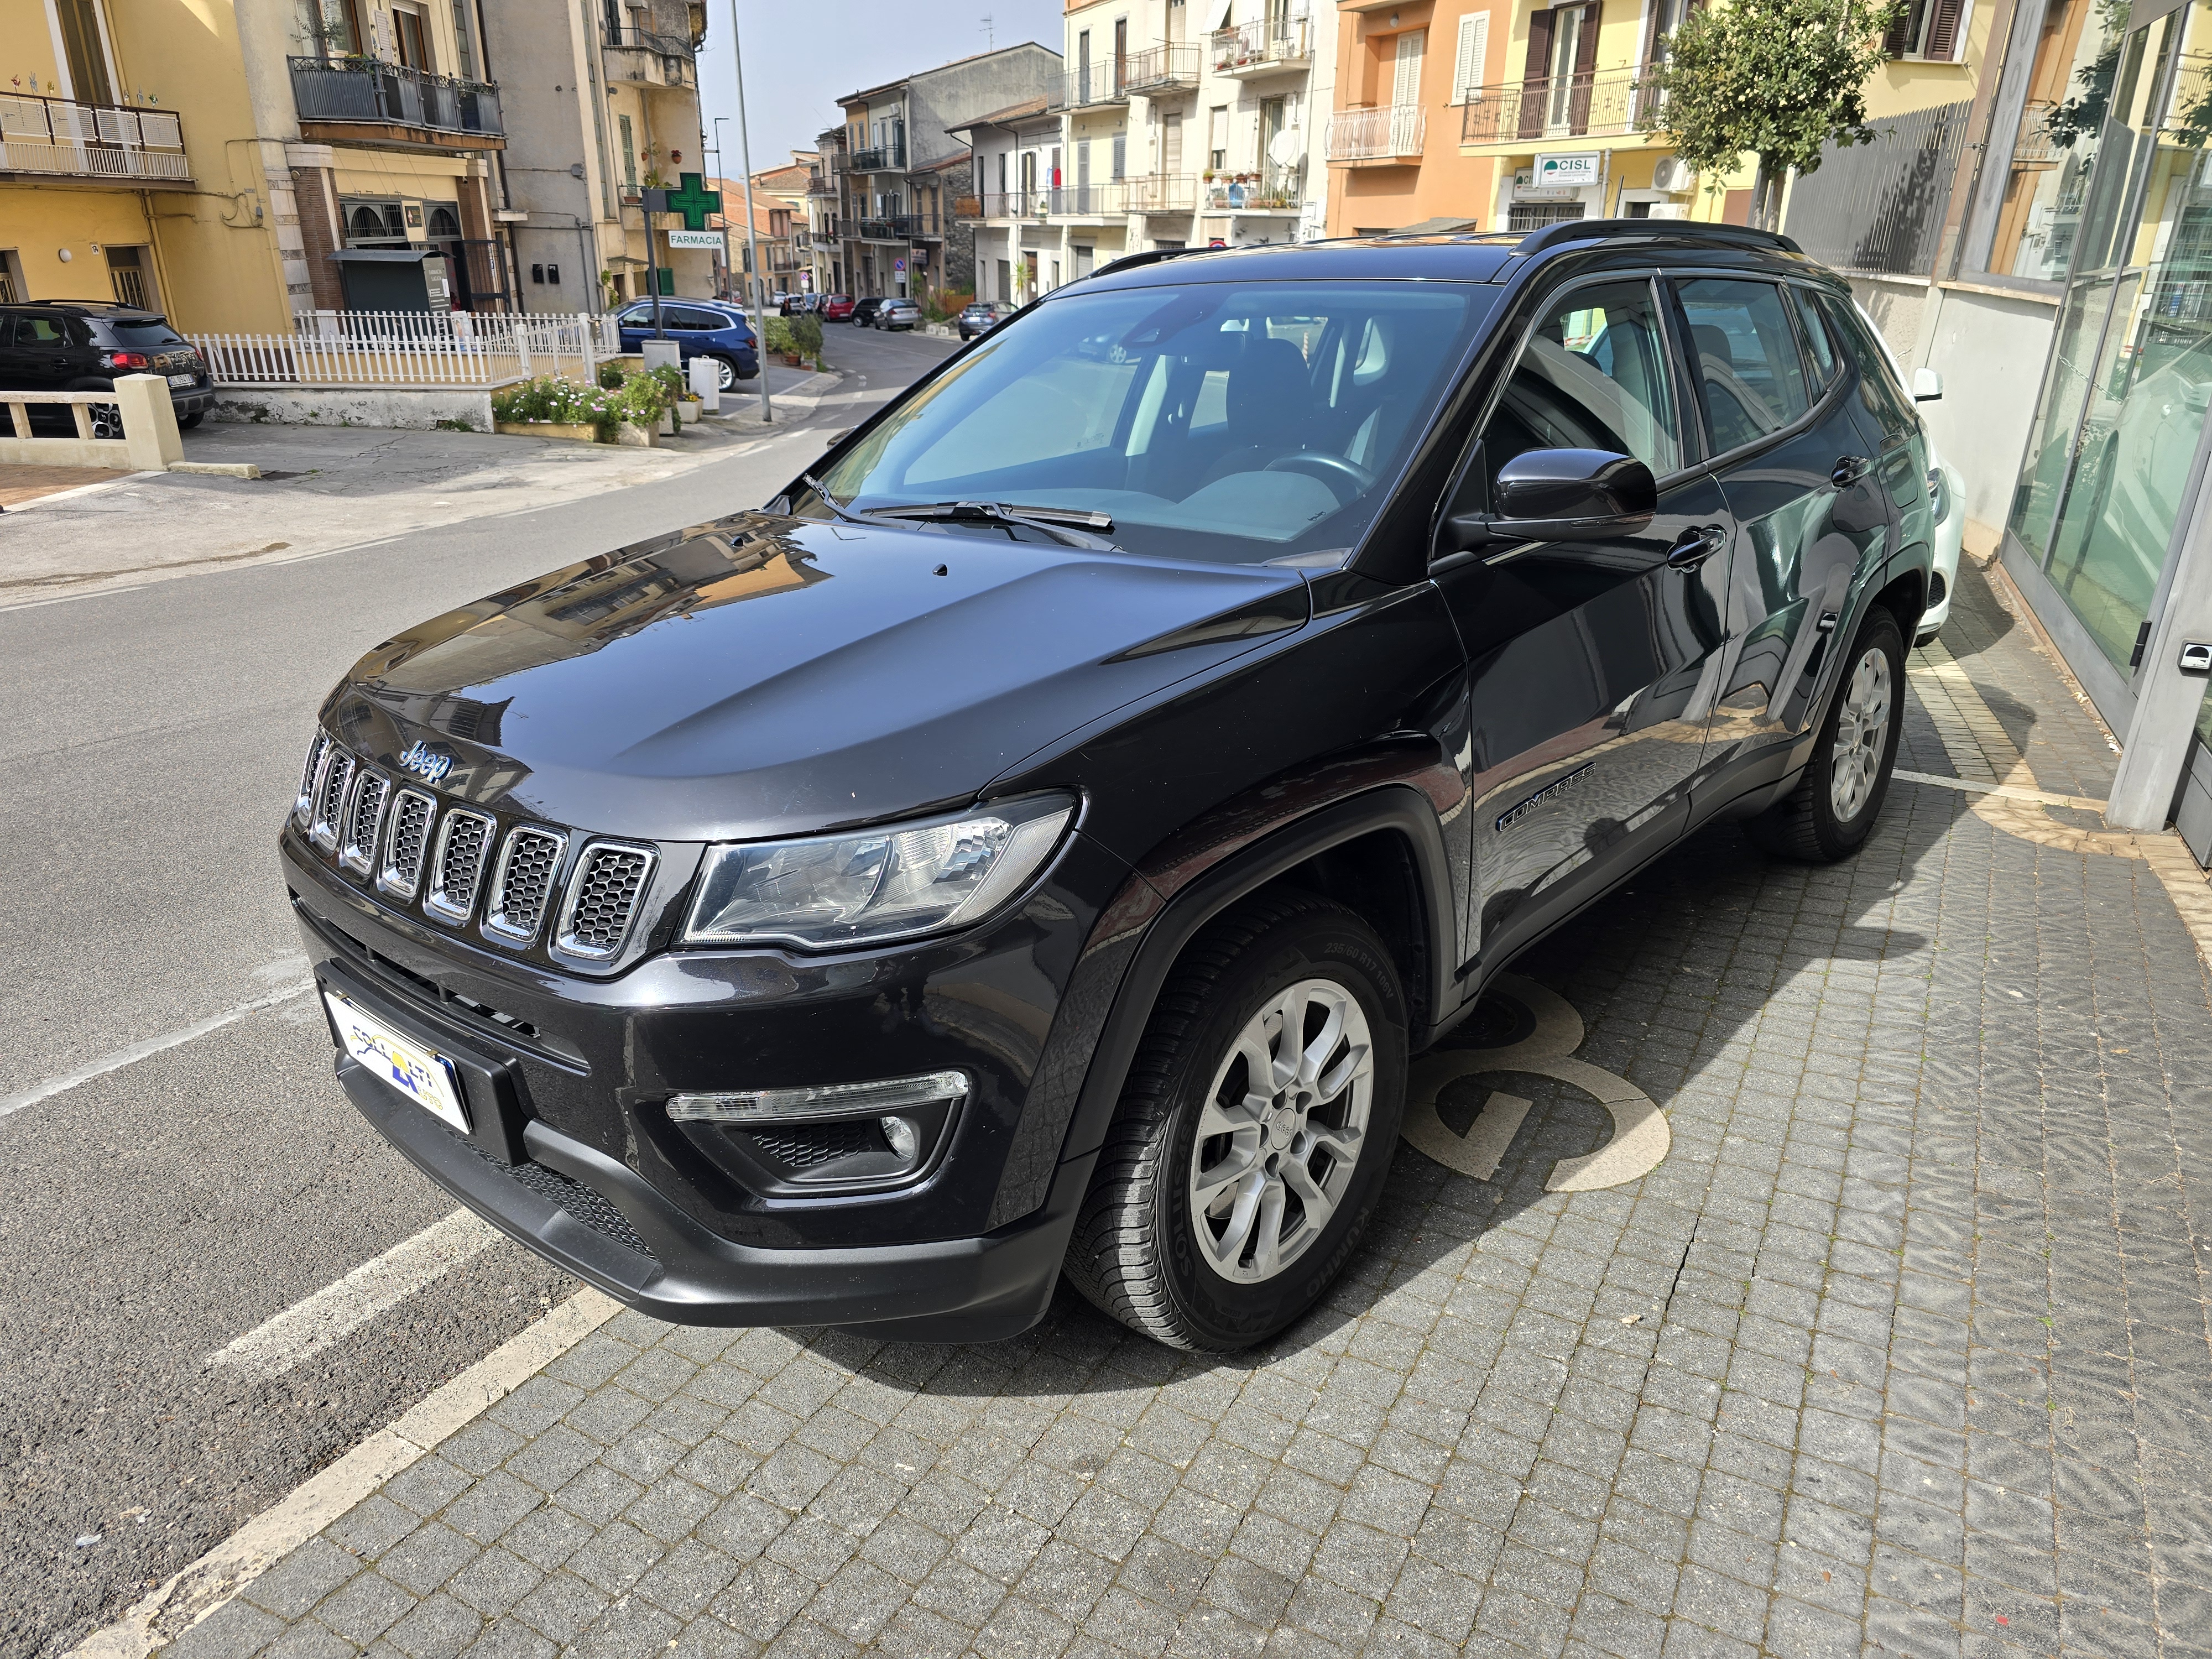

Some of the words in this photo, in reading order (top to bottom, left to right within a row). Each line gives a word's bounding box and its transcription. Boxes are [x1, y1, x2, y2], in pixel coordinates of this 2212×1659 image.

[1559, 160, 1591, 170] CISL
[671, 235, 722, 245] FARMACIA
[398, 740, 453, 784] Jeep
[1495, 761, 1597, 832] COMPASS
[1324, 942, 1359, 959] 235/60
[1359, 952, 1378, 972] R17
[1377, 970, 1394, 1000] 106V
[1178, 1123, 1192, 1160] 4S
[1173, 1163, 1193, 1277] SOLUS
[1306, 1206, 1370, 1298] KUMHO
